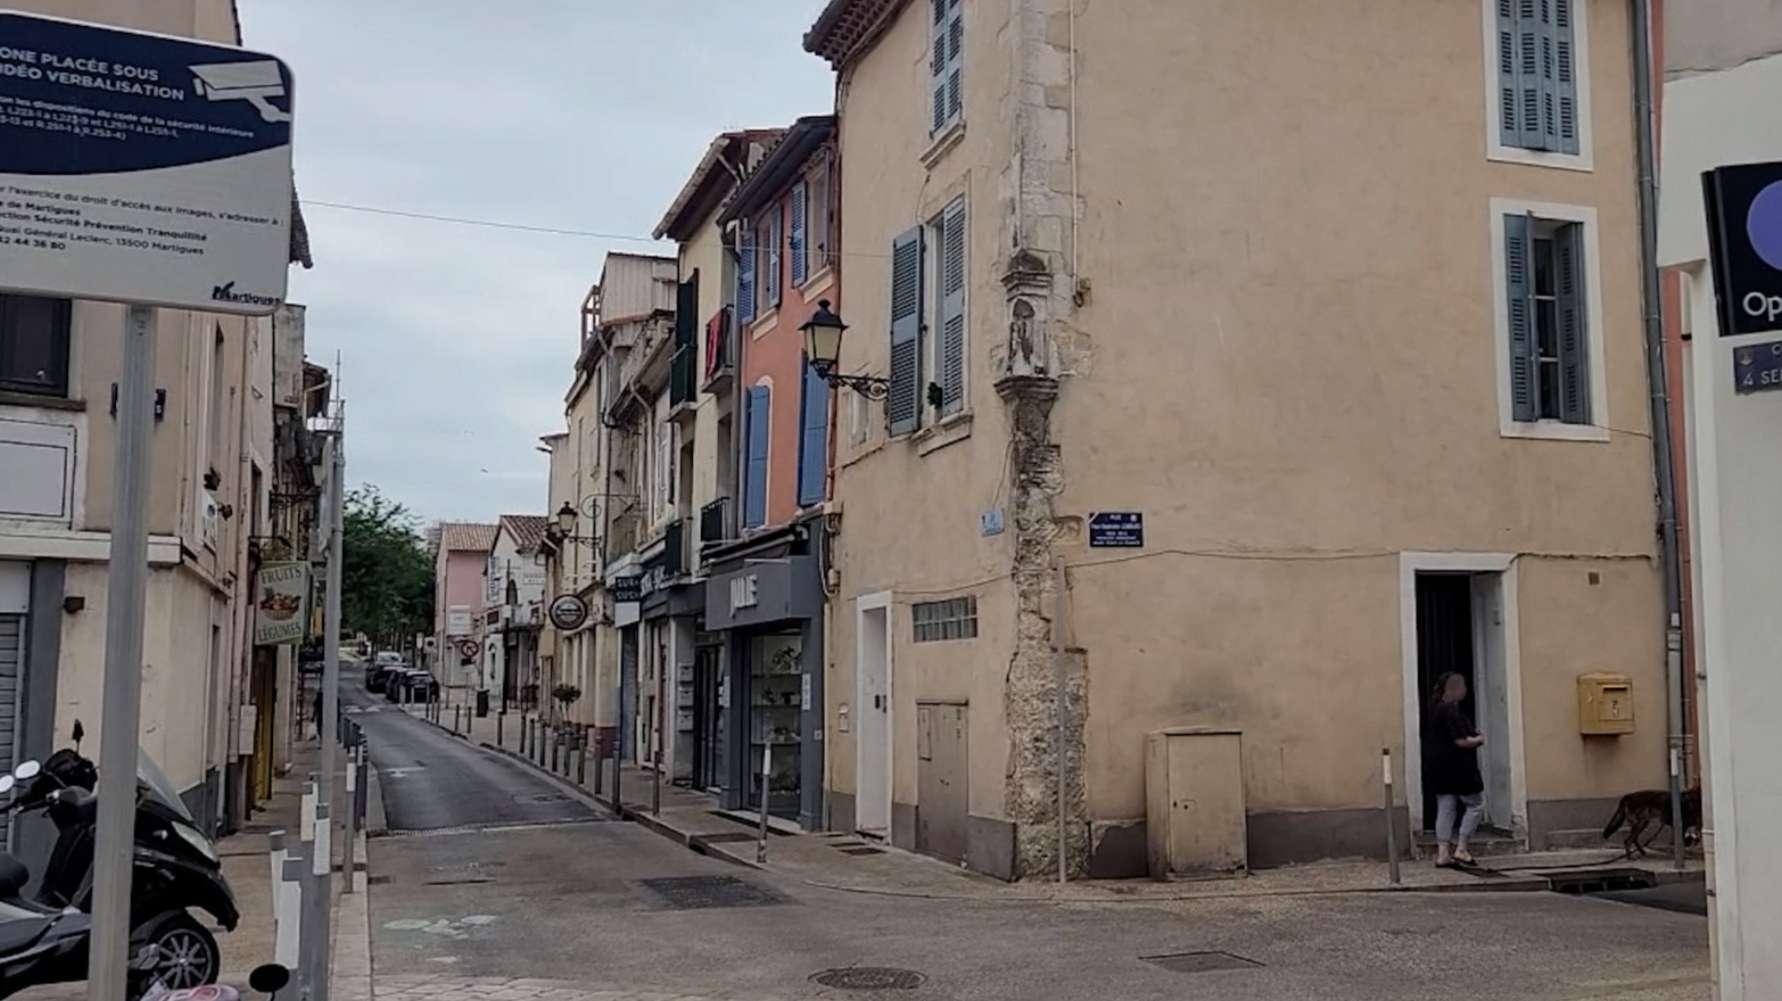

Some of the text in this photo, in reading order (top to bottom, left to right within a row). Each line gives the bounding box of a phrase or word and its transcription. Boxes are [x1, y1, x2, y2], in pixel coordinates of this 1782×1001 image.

[41, 53, 108, 74] PLACÉE
[113, 64, 159, 81] SOUS
[46, 70, 184, 100] VERBALISATION
[97, 110, 112, 119] du
[113, 111, 138, 121] code
[140, 113, 153, 124] de
[155, 116, 165, 126] la
[26, 202, 80, 216] Martigues
[64, 193, 79, 201] du
[81, 195, 108, 205] droit
[111, 199, 151, 211] d'accès
[154, 205, 172, 213] aux
[219, 212, 269, 224] s'adresser
[34, 214, 80, 227] Sécurité
[84, 220, 143, 233] Prévention
[147, 228, 207, 241] Tranquillité
[14, 238, 29, 246] 44
[24, 228, 67, 239] Général
[116, 238, 150, 249] 13500
[152, 242, 204, 255] Martigues
[262, 566, 302, 585] FRUITS
